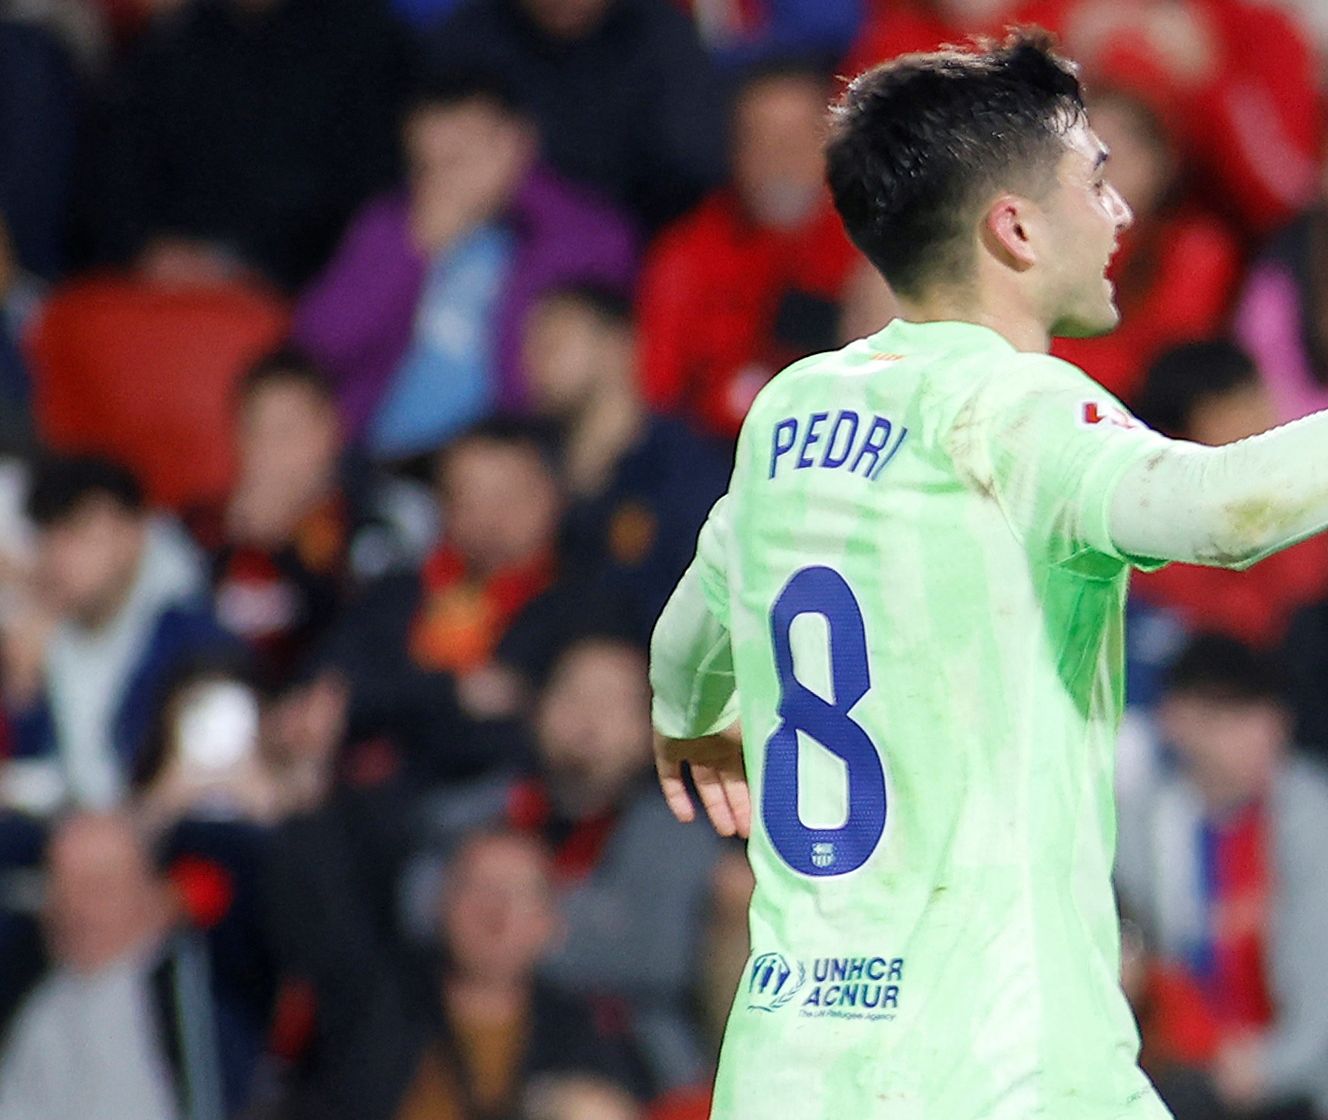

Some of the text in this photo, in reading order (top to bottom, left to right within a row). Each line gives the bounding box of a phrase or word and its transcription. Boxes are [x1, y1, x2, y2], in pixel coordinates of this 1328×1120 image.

[768, 408, 908, 481] PEDRI
[760, 564, 888, 877] 8
[813, 956, 905, 983] UNHCR
[803, 984, 900, 1008] ACNUR
